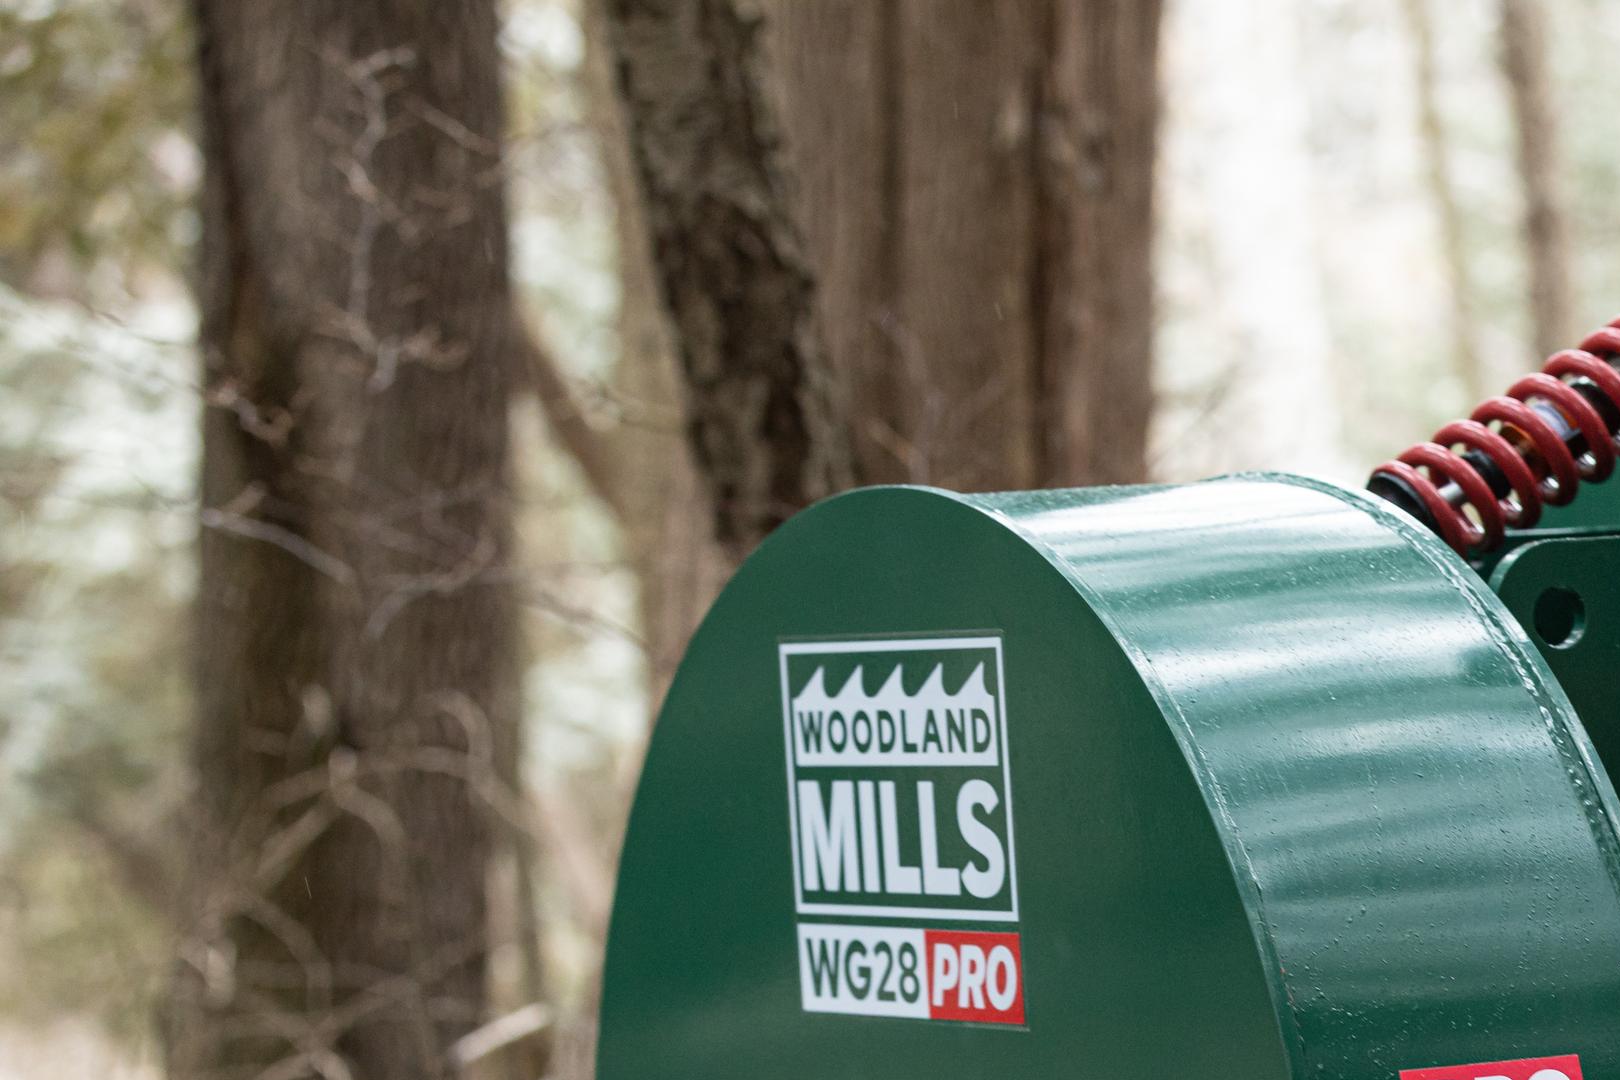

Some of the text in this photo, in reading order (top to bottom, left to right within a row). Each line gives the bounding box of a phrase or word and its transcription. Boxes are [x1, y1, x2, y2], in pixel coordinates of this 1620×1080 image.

[799, 708, 991, 754] WOODLAND
[798, 779, 1005, 898] MILLS
[806, 937, 1017, 1011] WG28 PRO
